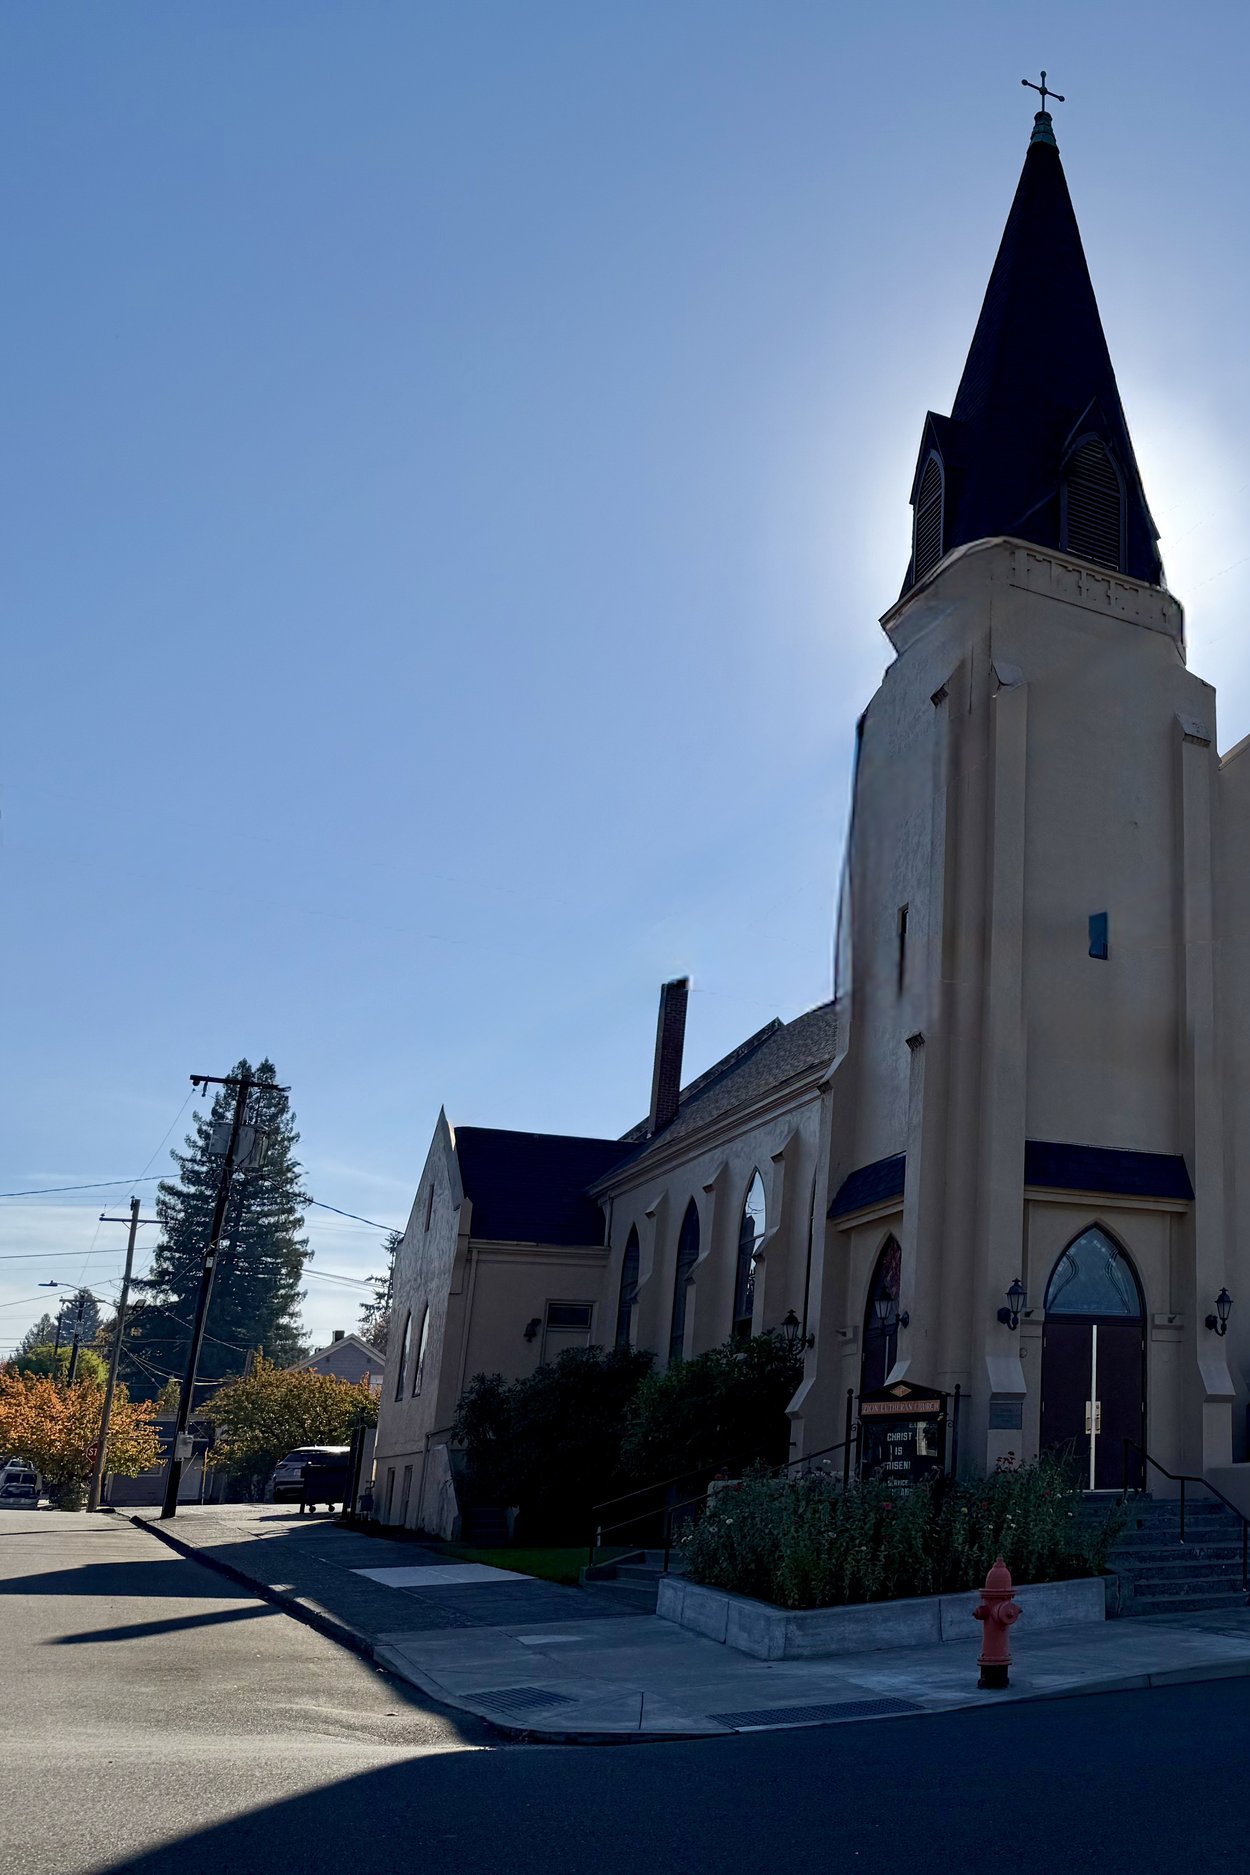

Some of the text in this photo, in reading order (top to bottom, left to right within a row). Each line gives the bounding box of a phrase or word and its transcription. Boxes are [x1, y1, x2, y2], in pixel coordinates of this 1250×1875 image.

[863, 1401, 939, 1414] ZION LUTHERAN CHURCH
[887, 1432, 913, 1441] CHRIST
[895, 1446, 903, 1456] IS
